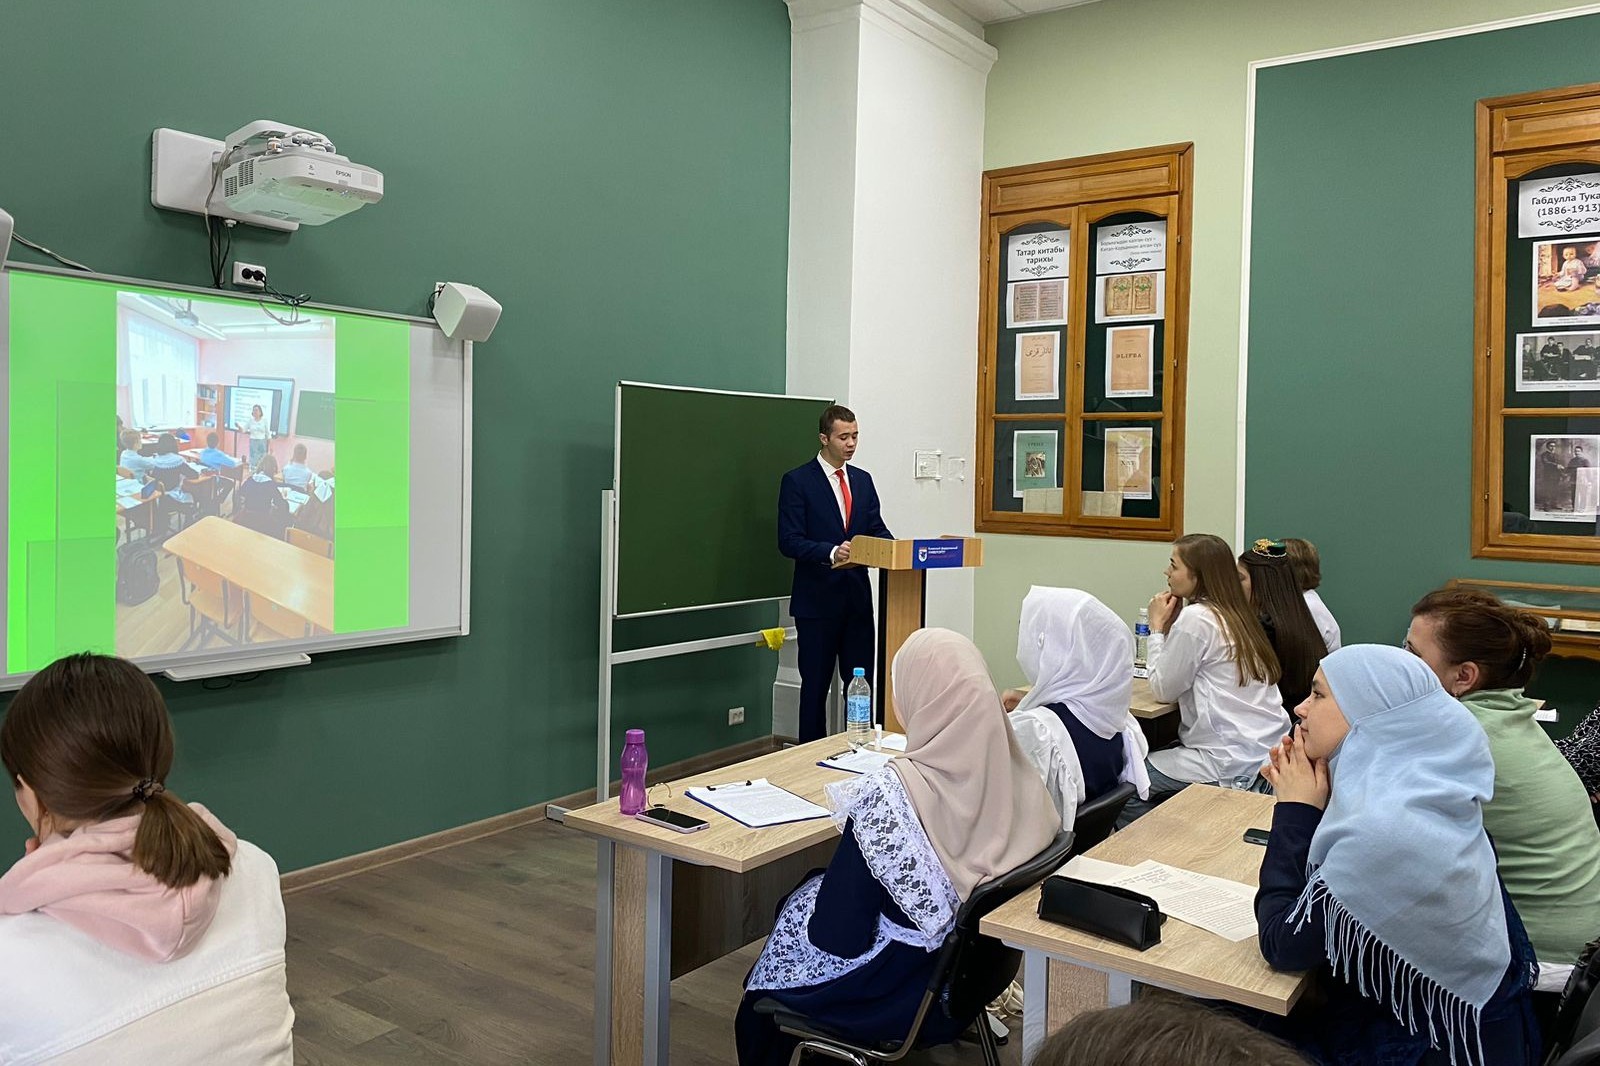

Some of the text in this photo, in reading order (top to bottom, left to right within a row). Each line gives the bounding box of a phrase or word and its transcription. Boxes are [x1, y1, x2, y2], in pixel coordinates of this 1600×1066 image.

[335, 169, 352, 178] EPSON
[1531, 193, 1600, 205] Габдулла Тука
[1537, 204, 1600, 217] (1886-1913)
[1016, 245, 1065, 257] Татар китабы
[1026, 256, 1054, 265] тарихы
